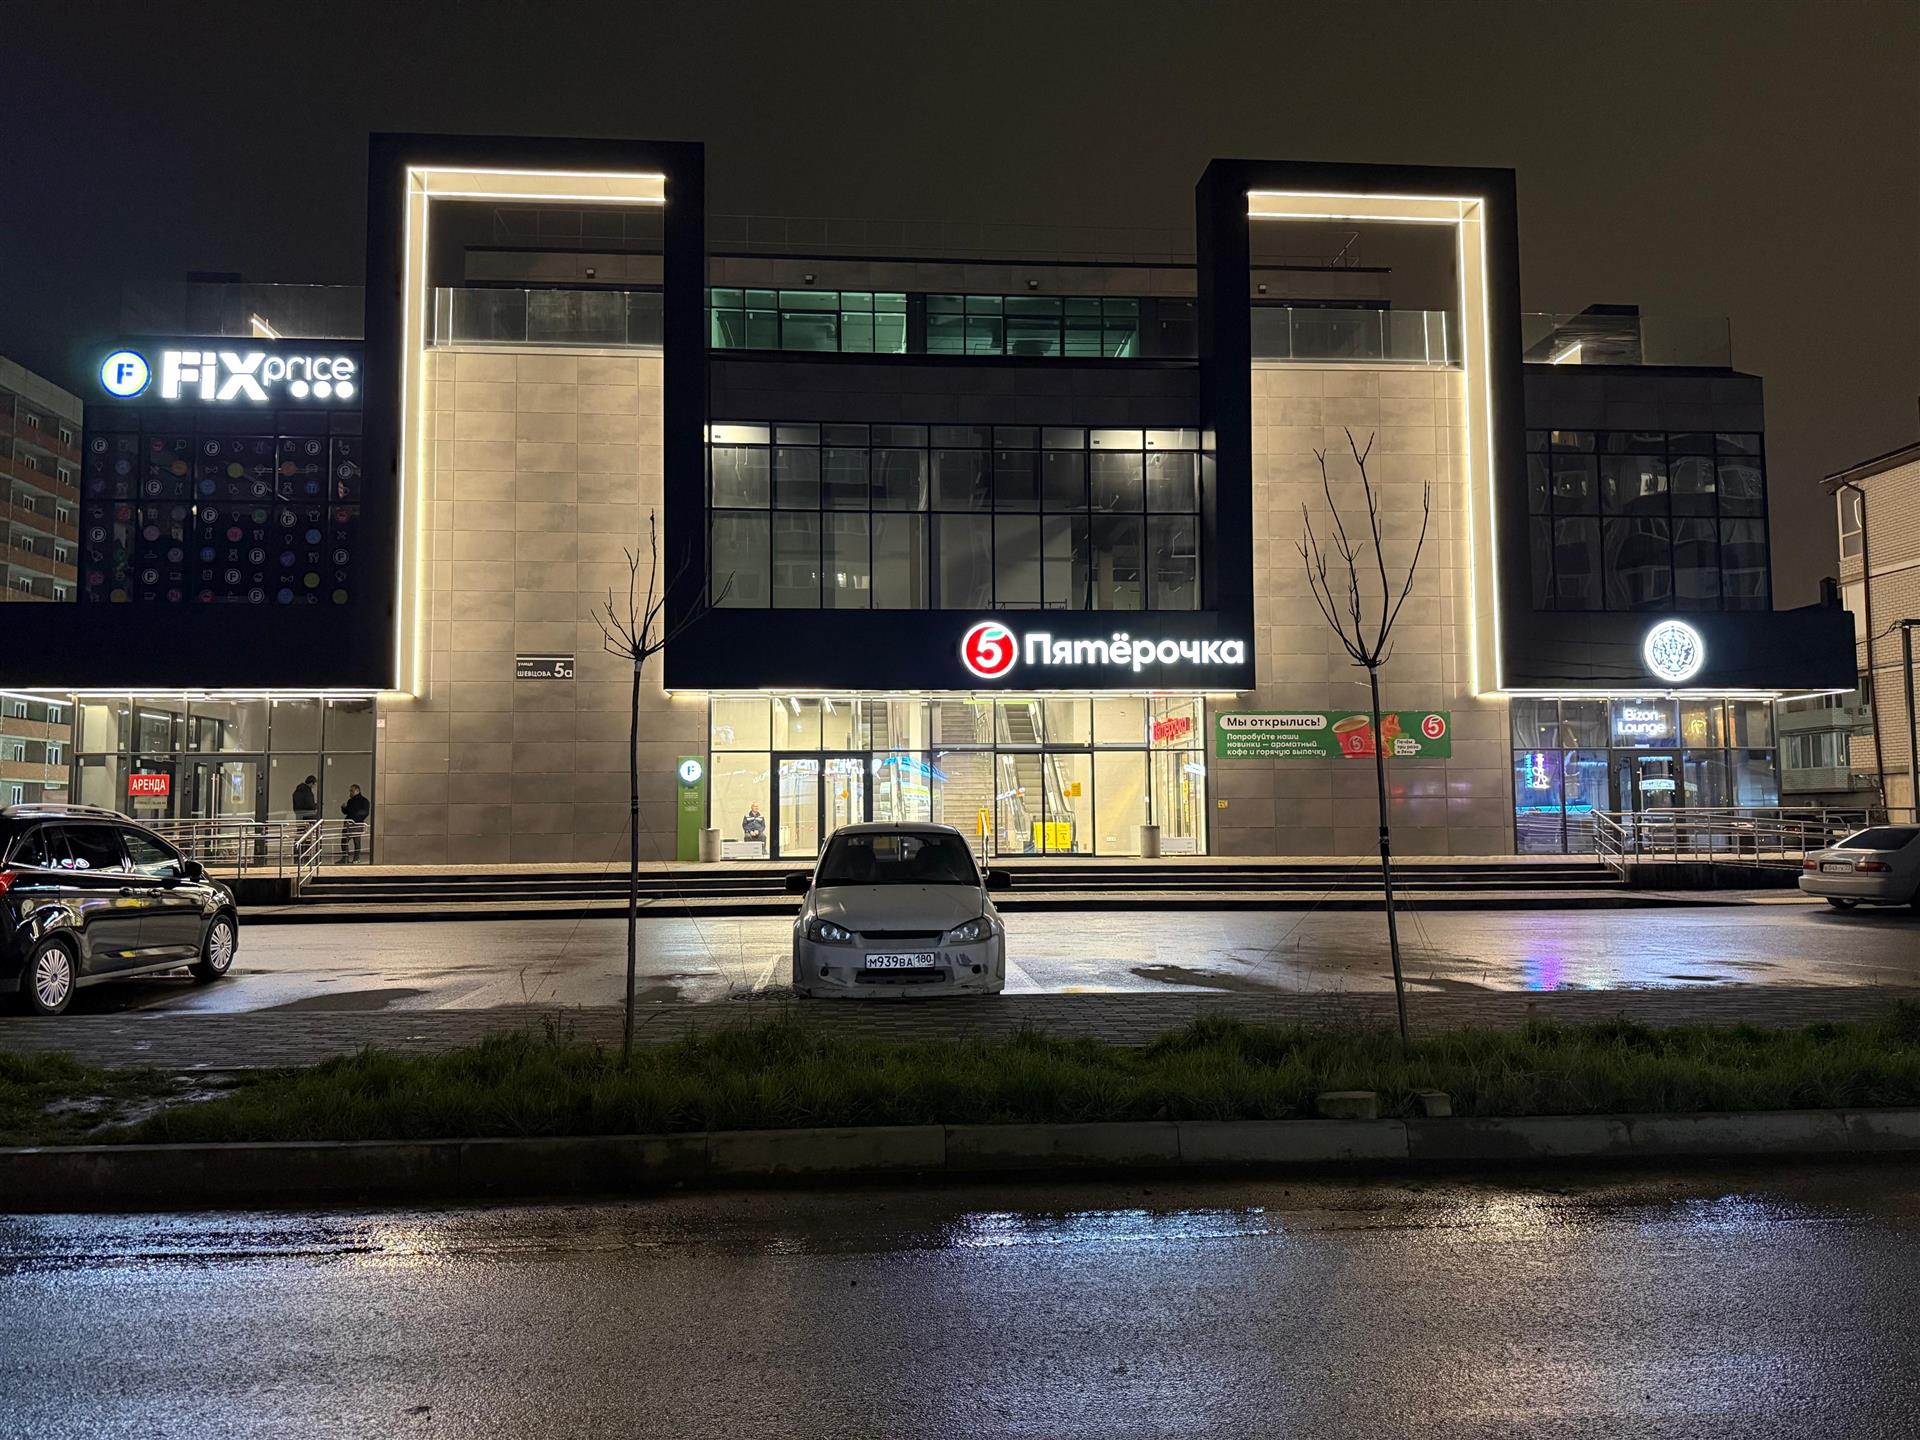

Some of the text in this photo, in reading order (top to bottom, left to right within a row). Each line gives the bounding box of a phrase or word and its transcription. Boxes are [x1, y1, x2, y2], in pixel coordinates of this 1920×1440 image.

[263, 356, 355, 387] price
[1025, 632, 1244, 672] Пятёрочка
[554, 662, 573, 678] 5а
[1623, 707, 1659, 721] Bizon
[1227, 717, 1321, 729] Мы открылись!
[1617, 720, 1666, 735] Lounge
[1226, 733, 1276, 742] Попробуйте
[1271, 740, 1318, 749] ароматный
[1226, 748, 1248, 756] кофе
[131, 778, 166, 793] АРЕНДА
